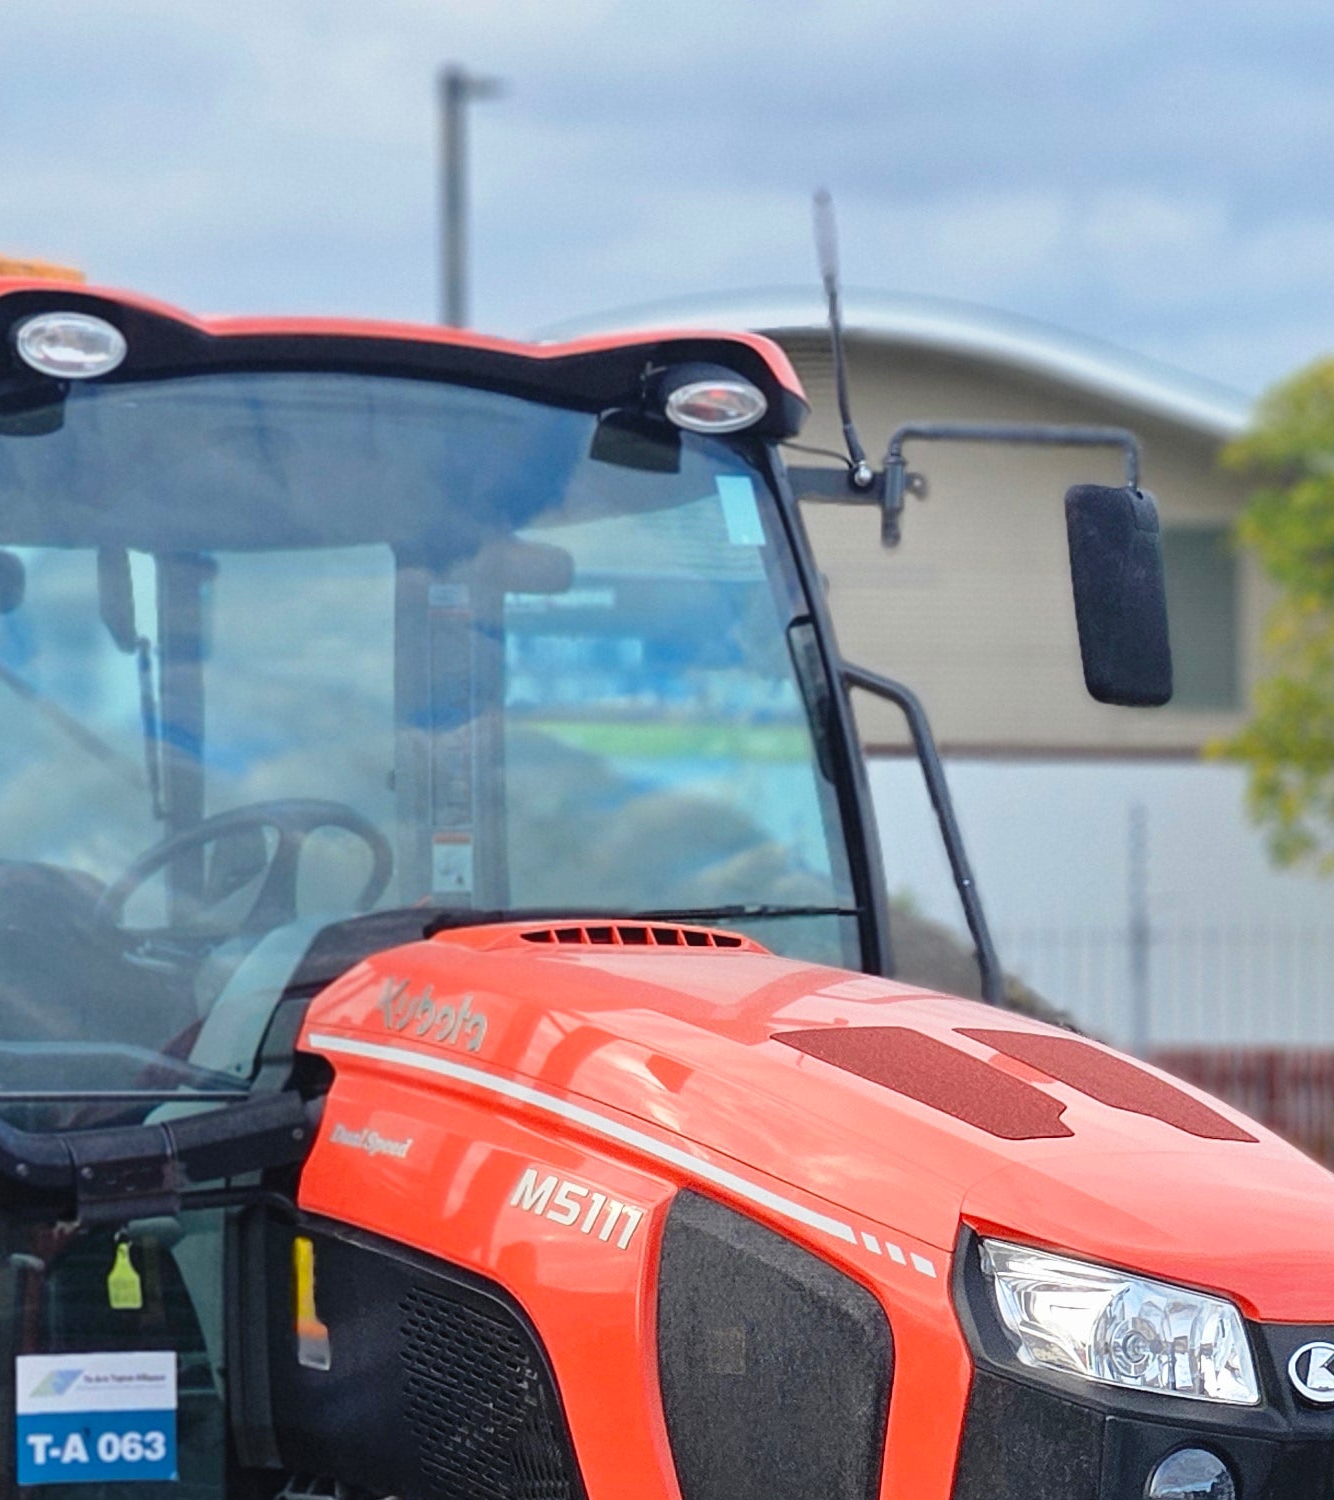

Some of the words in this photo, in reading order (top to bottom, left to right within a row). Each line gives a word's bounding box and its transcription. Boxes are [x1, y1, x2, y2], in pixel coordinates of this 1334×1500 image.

[378, 976, 487, 1053] Kubota
[509, 1168, 644, 1250] M5111
[27, 1433, 90, 1465] T-A
[97, 1431, 166, 1463] 063
